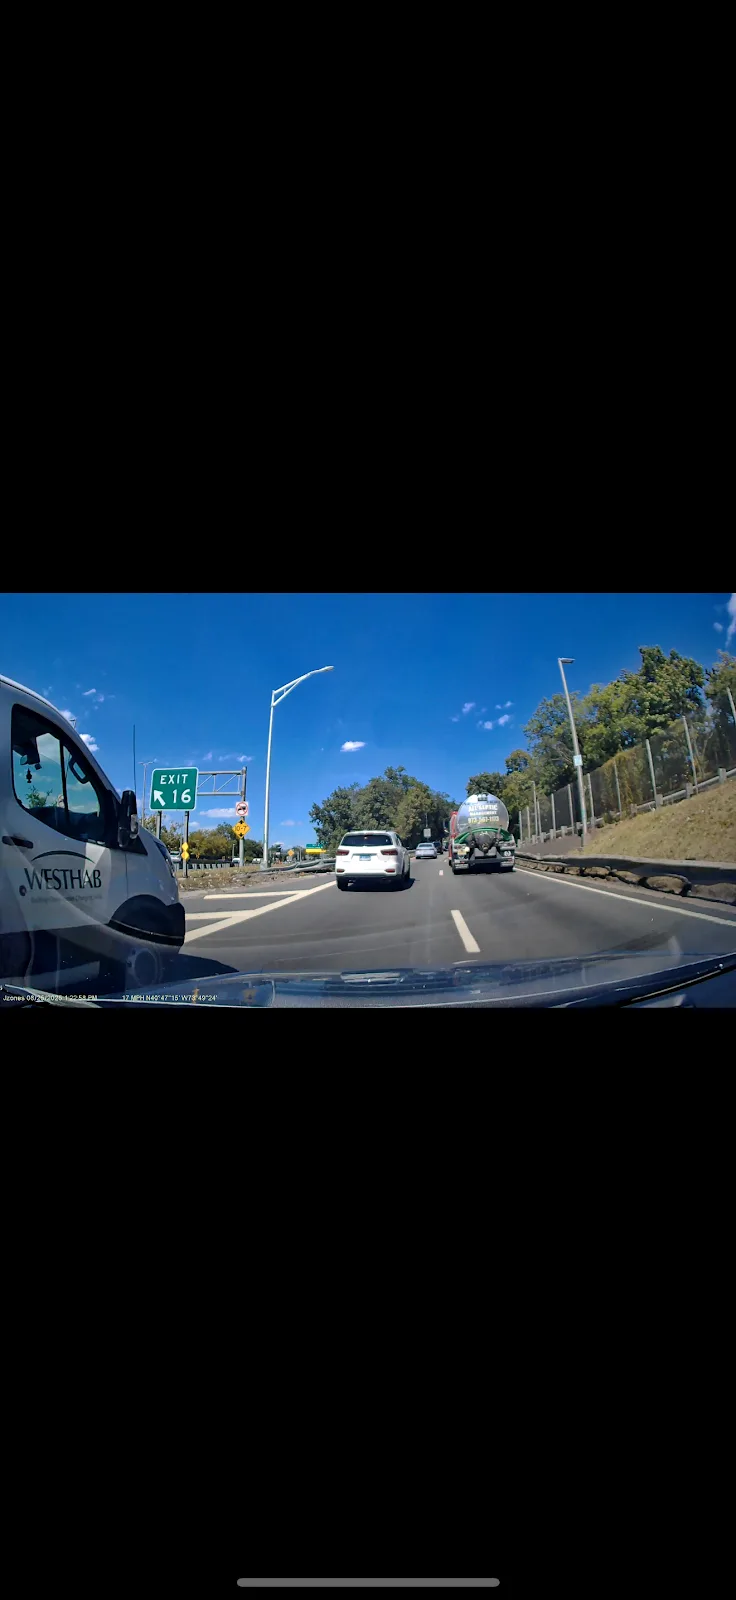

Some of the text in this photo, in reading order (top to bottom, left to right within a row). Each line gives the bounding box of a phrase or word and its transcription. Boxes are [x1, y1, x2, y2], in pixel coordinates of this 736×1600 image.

[160, 774, 188, 785] EXIT
[172, 788, 192, 804] 16
[23, 868, 102, 890] WESTHAB
